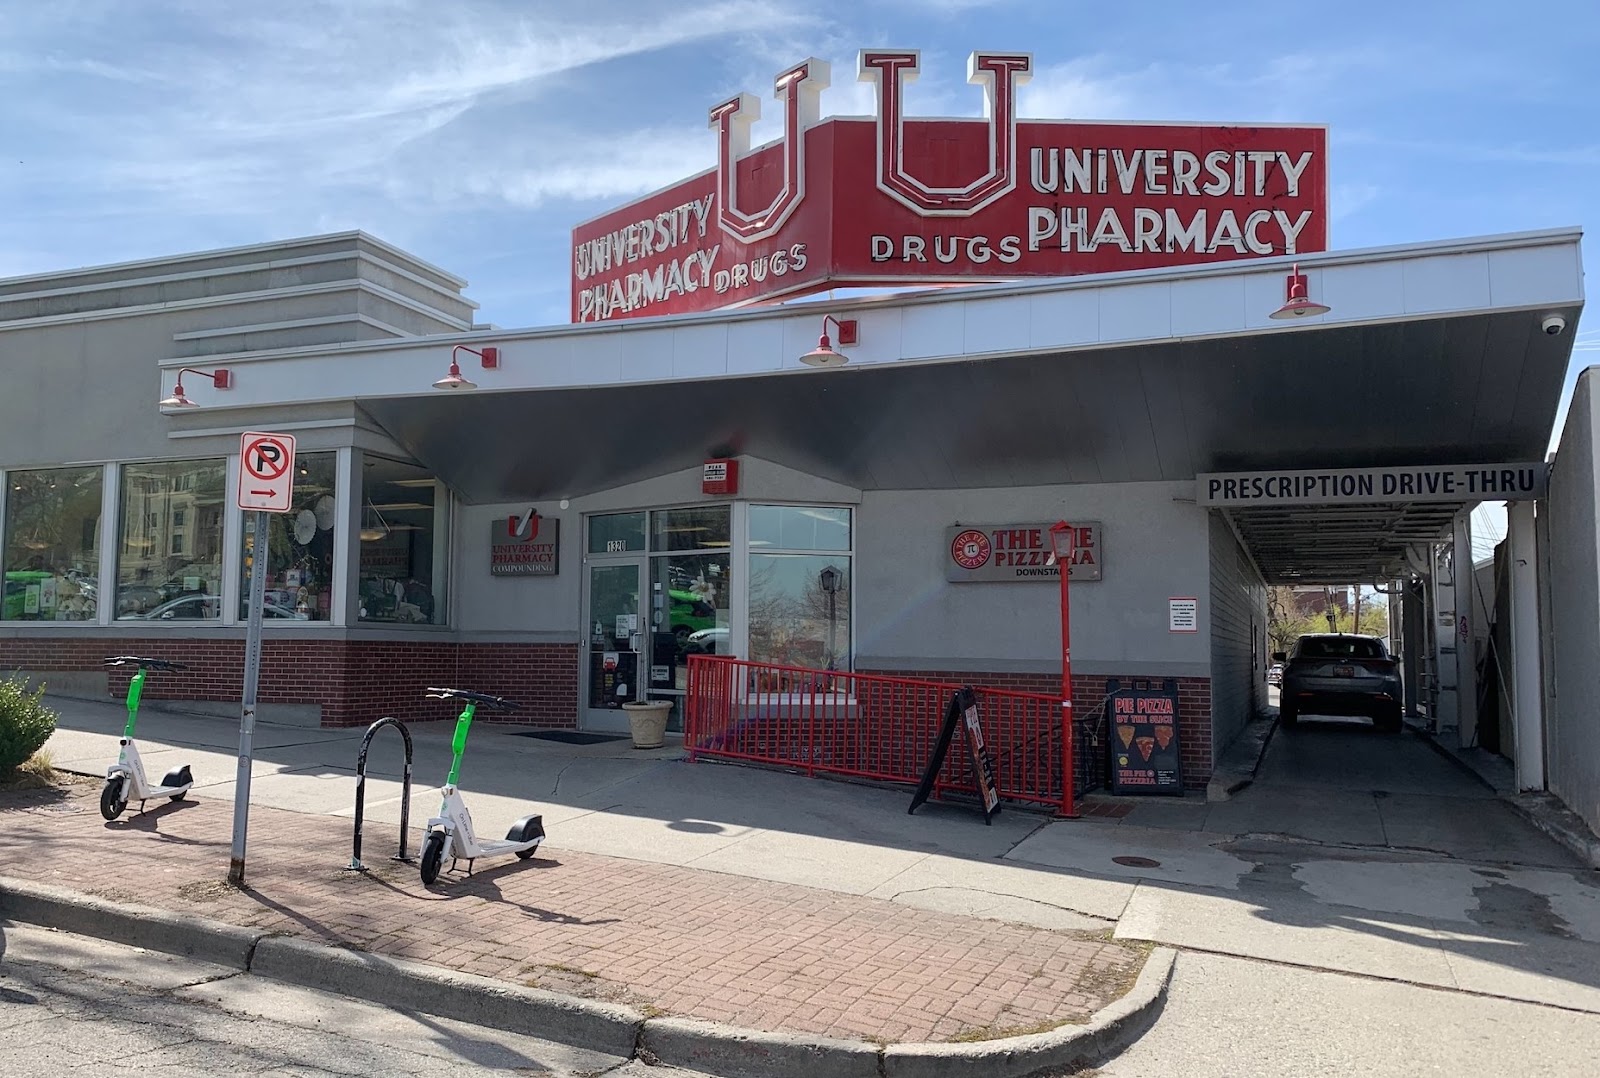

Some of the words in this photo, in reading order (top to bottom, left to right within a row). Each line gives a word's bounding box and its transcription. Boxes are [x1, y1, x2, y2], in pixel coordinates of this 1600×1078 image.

[856, 49, 1034, 218] U
[708, 57, 832, 245] U
[1029, 147, 1313, 197] UNIVERSITY
[574, 192, 716, 281] UNIVERSITY
[1028, 206, 1312, 255] PHARMACY
[871, 235, 1021, 264] DRUGS
[713, 242, 808, 294] DRUGS
[577, 244, 721, 323] PHARMACY
[1208, 473, 1374, 500] PRESCRIPTION
[1382, 469, 1535, 496] DRIVE-THRU
[493, 544, 554, 553] UNIVERSITY
[608, 541, 625, 552] 1320
[992, 529, 1043, 550] THE
[492, 564, 552, 573] COMPOUNDING
[493, 554, 553, 564] PHARMACY
[1115, 698, 1134, 714] PIE
[1137, 698, 1173, 714] PIZZA
[1131, 715, 1147, 723] THE
